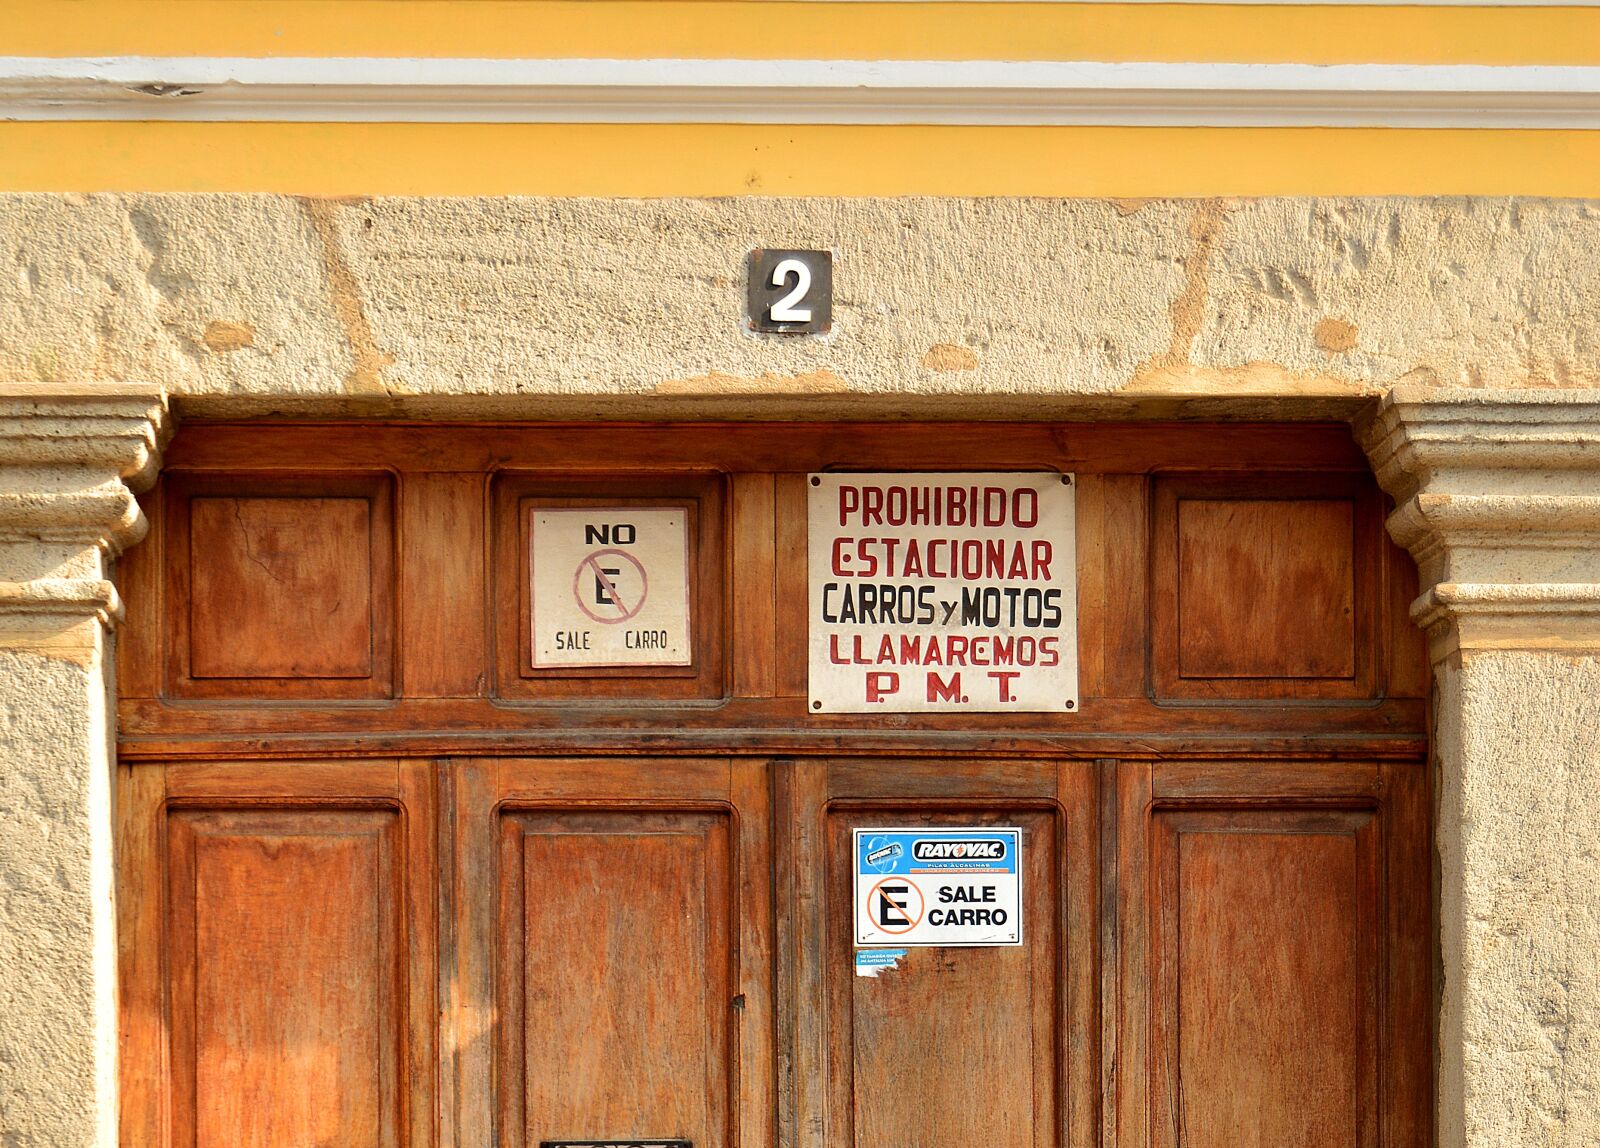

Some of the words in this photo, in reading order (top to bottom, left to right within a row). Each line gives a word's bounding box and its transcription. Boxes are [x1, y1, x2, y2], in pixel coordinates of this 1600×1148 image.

[770, 259, 812, 322] 2
[839, 485, 1039, 529] PROHIBIDO
[585, 524, 636, 545] NO
[831, 537, 1053, 581] ESTACIONAR
[822, 583, 936, 625] CARROS
[940, 600, 959, 626] y
[961, 586, 1062, 628] MOTOS
[556, 631, 591, 650] SALE
[625, 630, 667, 649] CARRO
[829, 633, 1060, 667] LLAMAREMOS
[938, 885, 997, 903] SALE
[928, 908, 1008, 926] CARRO
